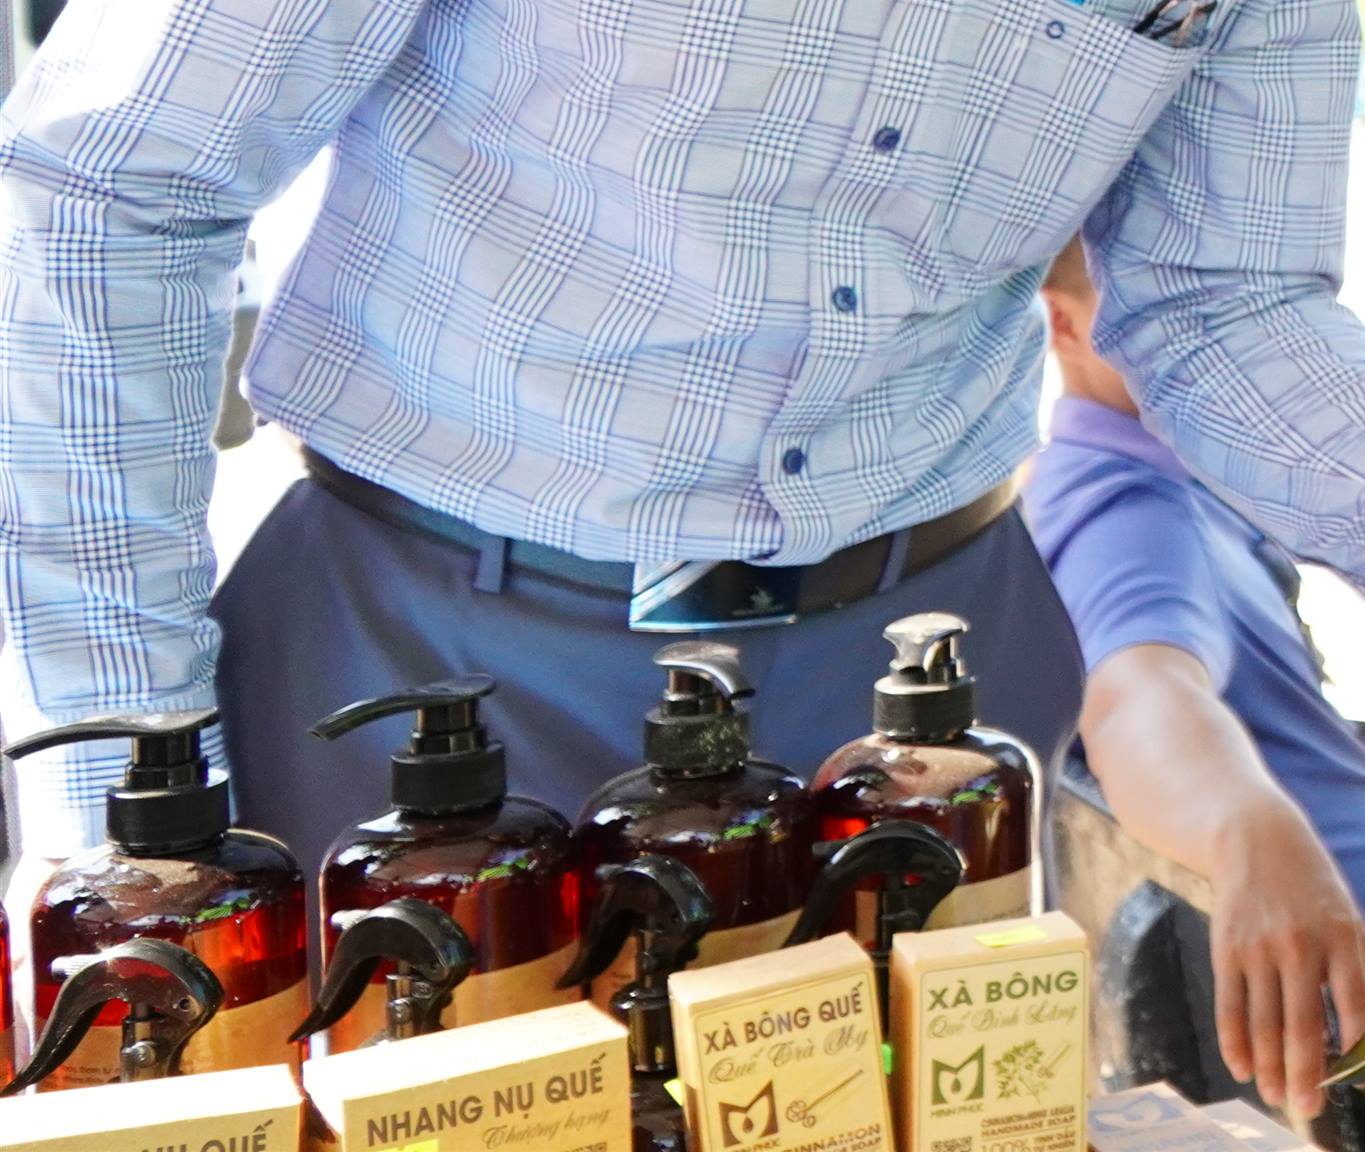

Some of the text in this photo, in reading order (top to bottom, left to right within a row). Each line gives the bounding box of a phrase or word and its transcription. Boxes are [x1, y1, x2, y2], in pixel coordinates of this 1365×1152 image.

[928, 970, 1079, 1011] XÀ BÔNG
[704, 981, 863, 1055] XÀ BÔNG QUẾ
[708, 1047, 763, 1084] Quế
[768, 1039, 815, 1068] Trà
[367, 1052, 607, 1147] NHANG NỤ QUẾ
[783, 1123, 881, 1152] NNAMON
